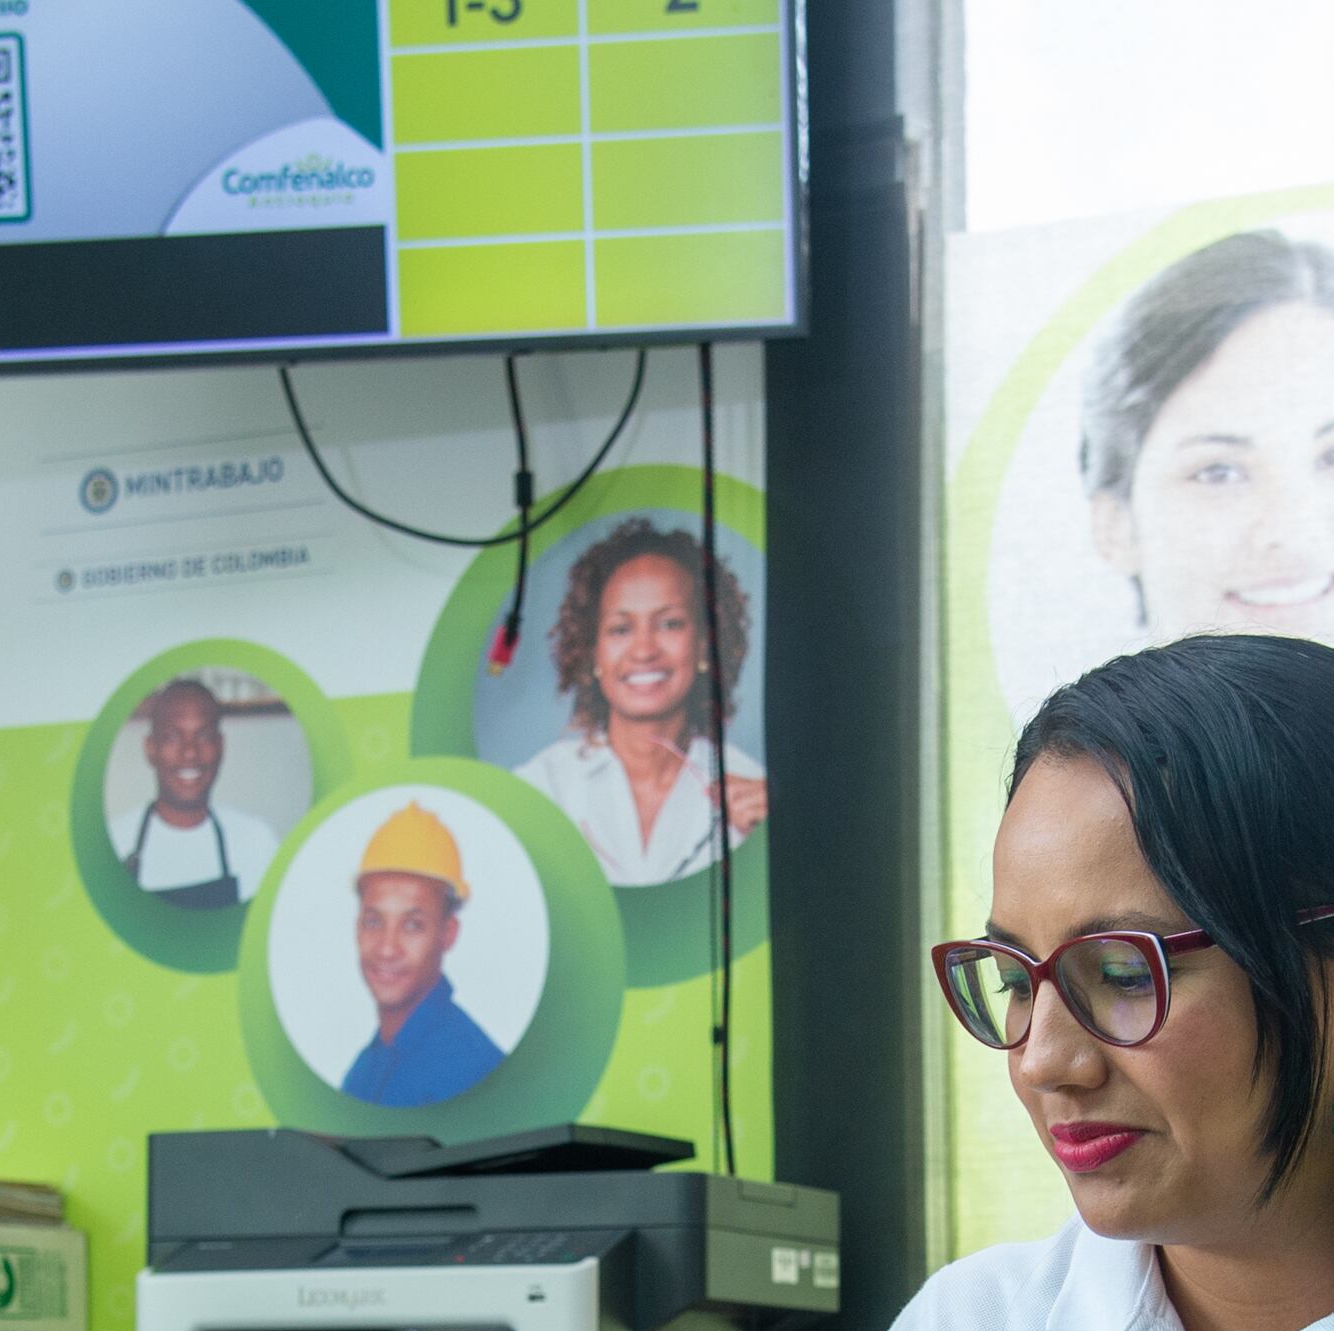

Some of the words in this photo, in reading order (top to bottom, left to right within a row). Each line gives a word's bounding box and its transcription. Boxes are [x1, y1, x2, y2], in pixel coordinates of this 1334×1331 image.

[222, 160, 376, 194] Comfenalco
[125, 455, 285, 498] MINTRABAJO
[81, 561, 178, 588] GOBIERNO
[182, 556, 206, 577] DE
[212, 546, 310, 575] COLOMBIA
